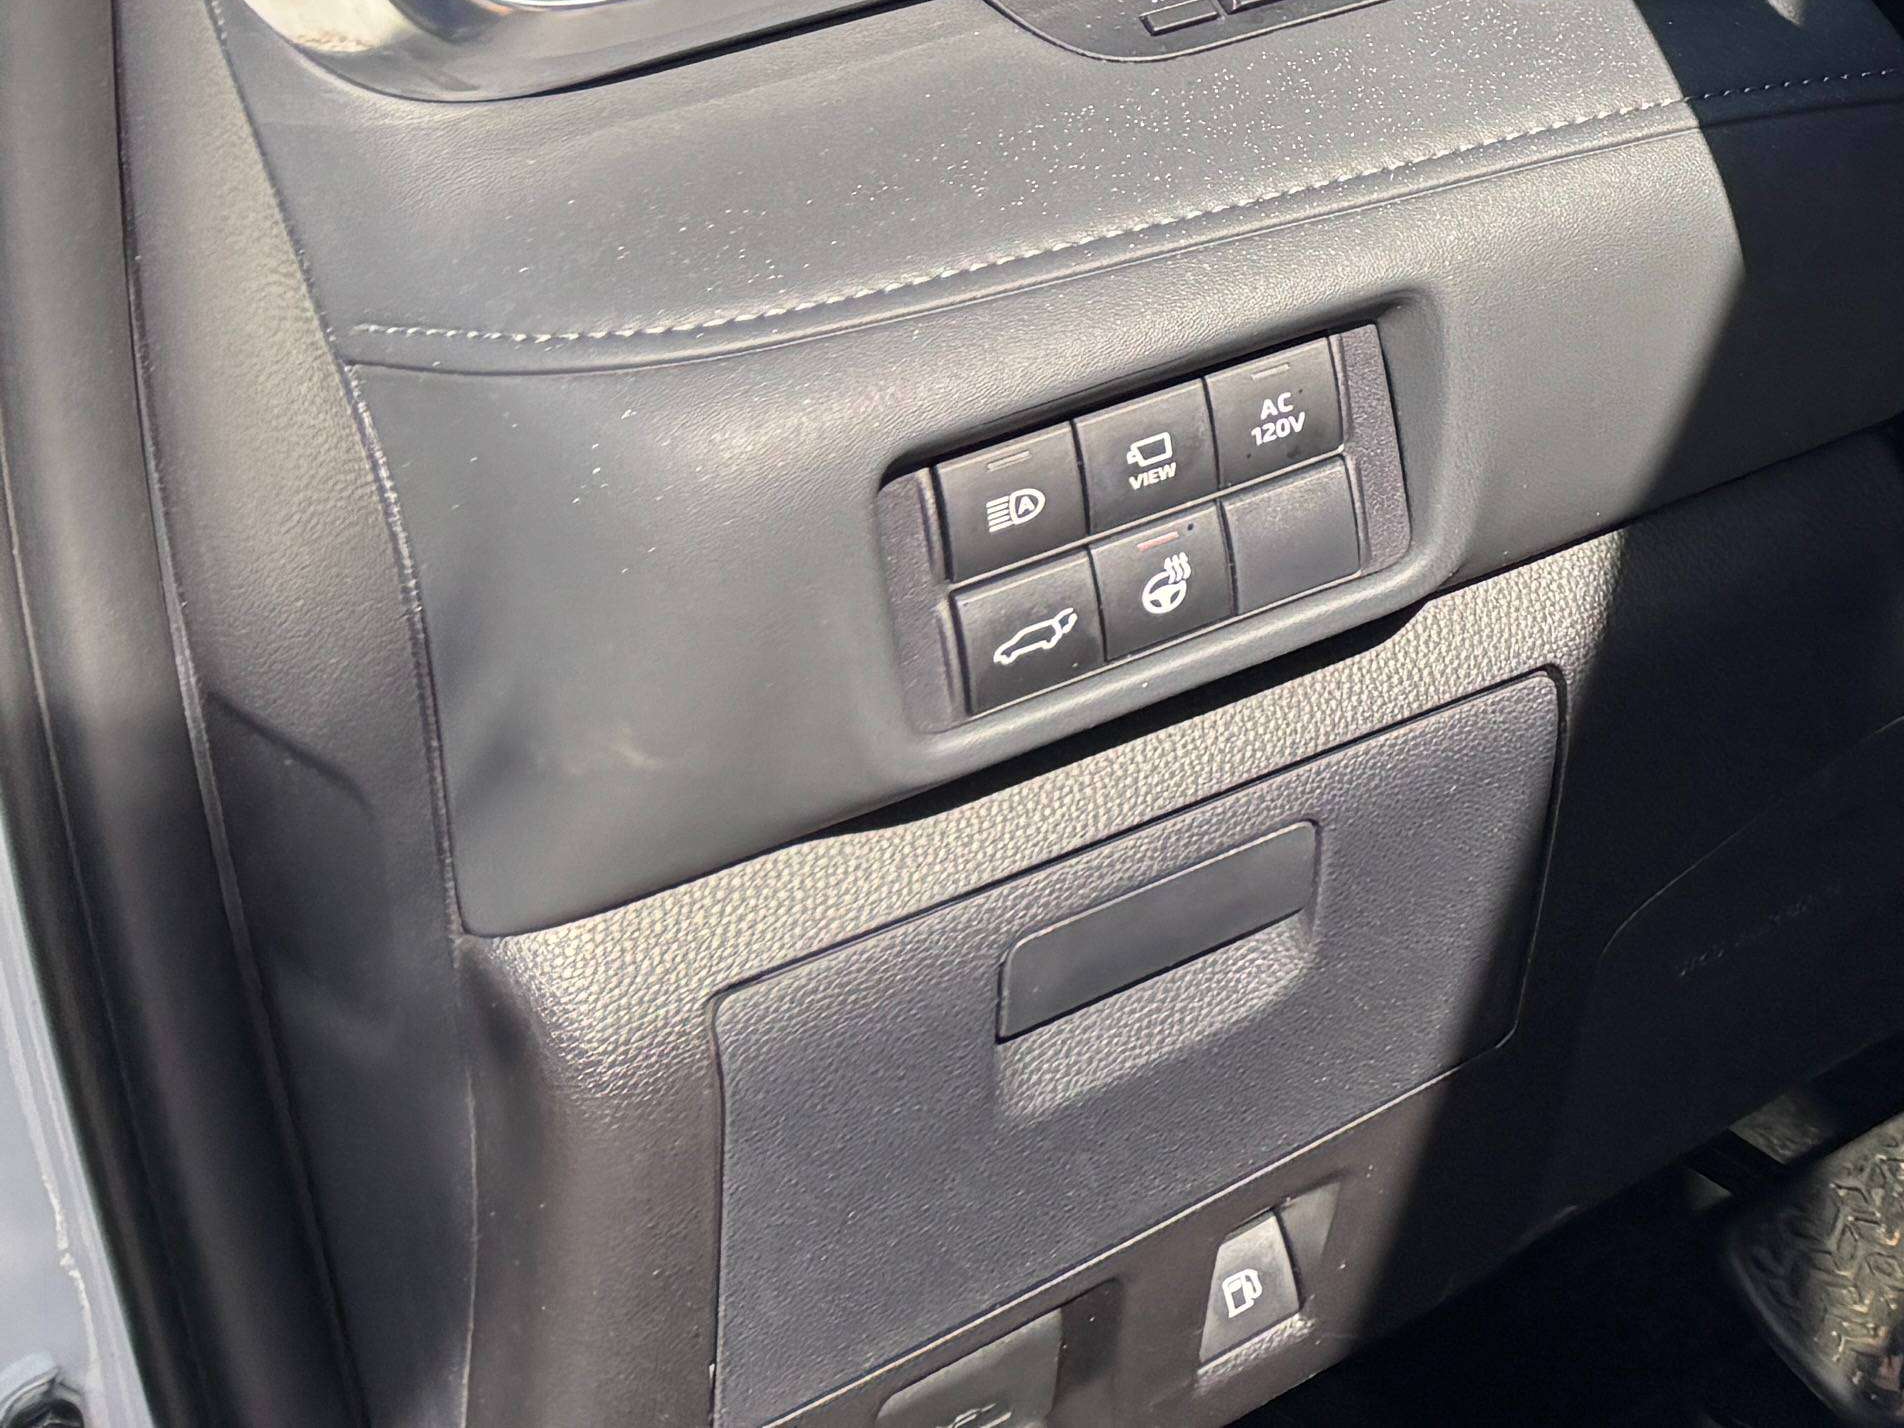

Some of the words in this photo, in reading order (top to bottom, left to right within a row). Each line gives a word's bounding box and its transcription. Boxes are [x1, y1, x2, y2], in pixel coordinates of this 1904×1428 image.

[1259, 391, 1294, 420] AC
[1250, 411, 1306, 447] 120V
[1128, 461, 1177, 491] VIEW
